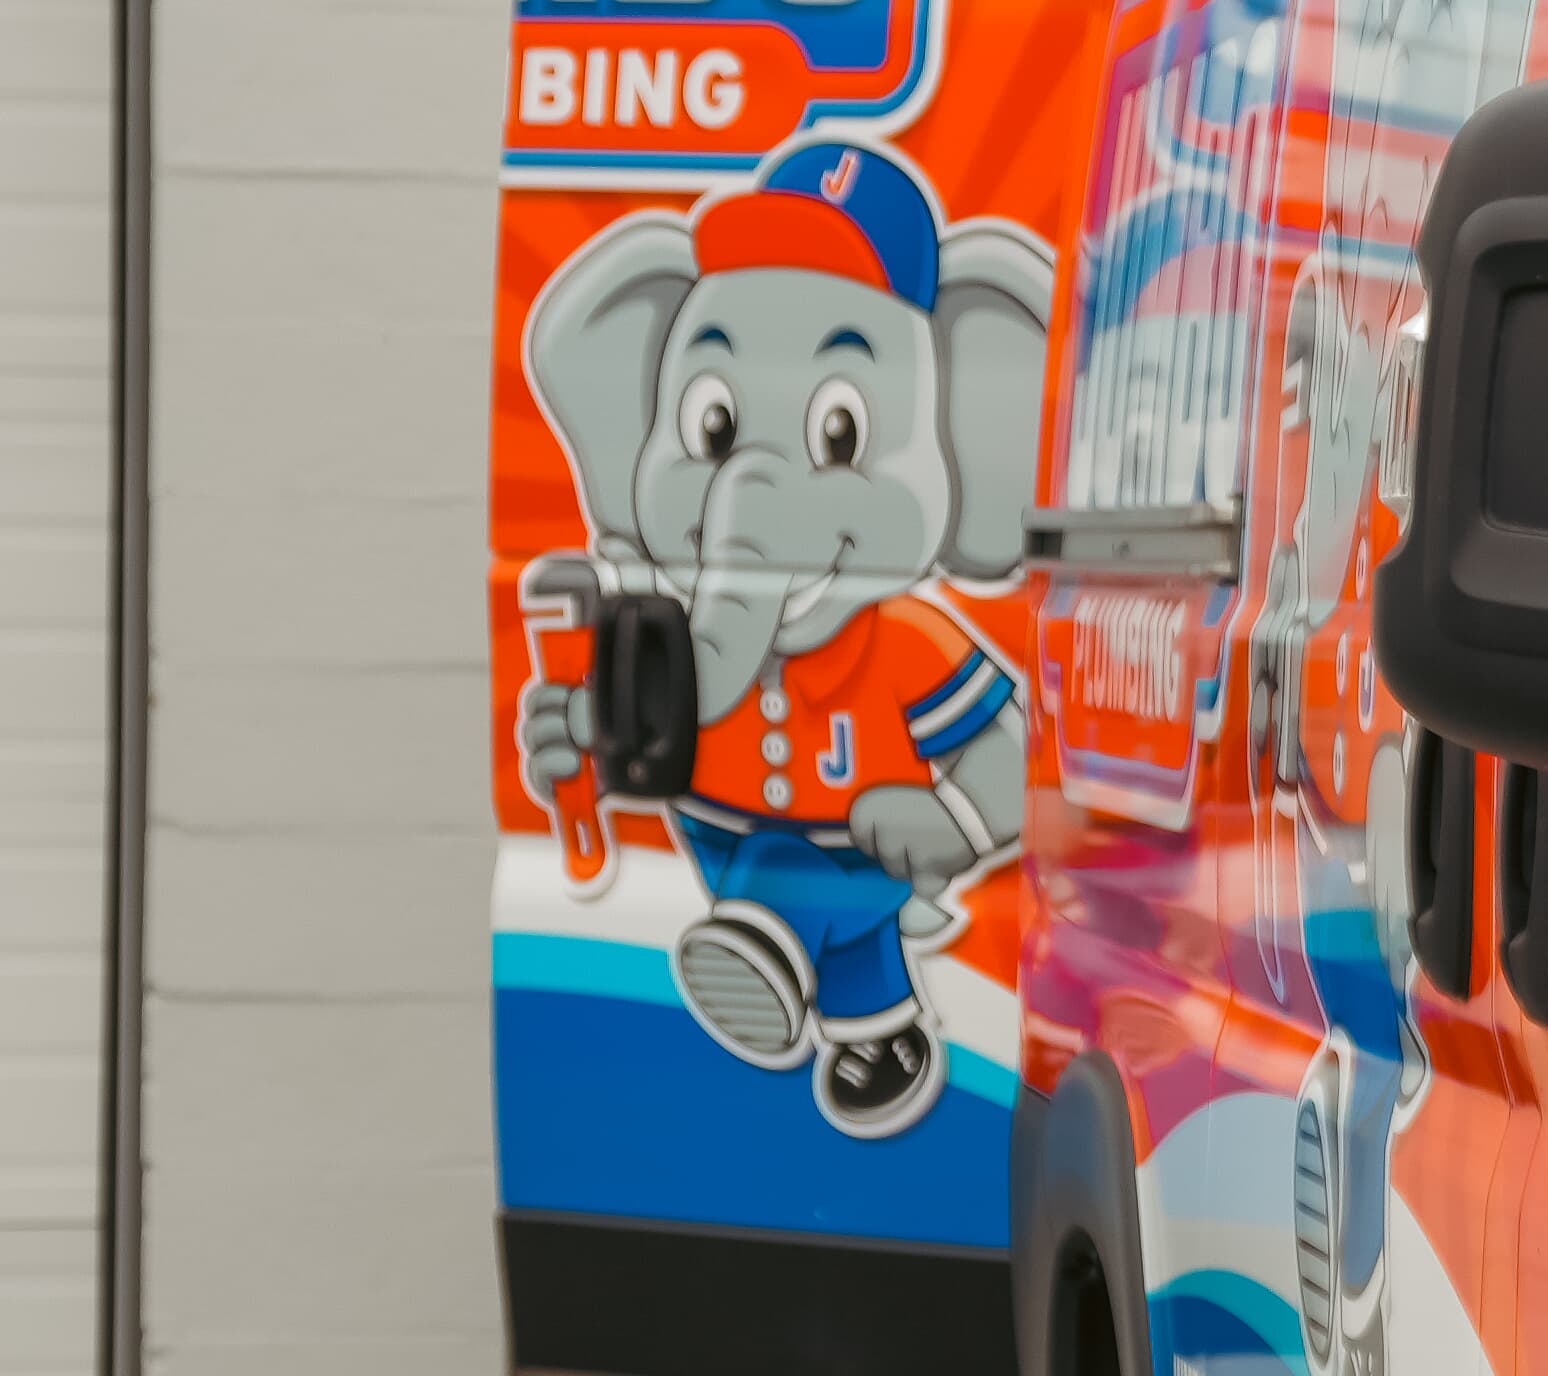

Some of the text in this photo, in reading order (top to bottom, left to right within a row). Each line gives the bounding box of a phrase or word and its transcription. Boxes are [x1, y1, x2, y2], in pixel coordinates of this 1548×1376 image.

[518, 47, 745, 131] BING
[1071, 595, 1187, 722] PLUMBING
[816, 711, 856, 788] J
